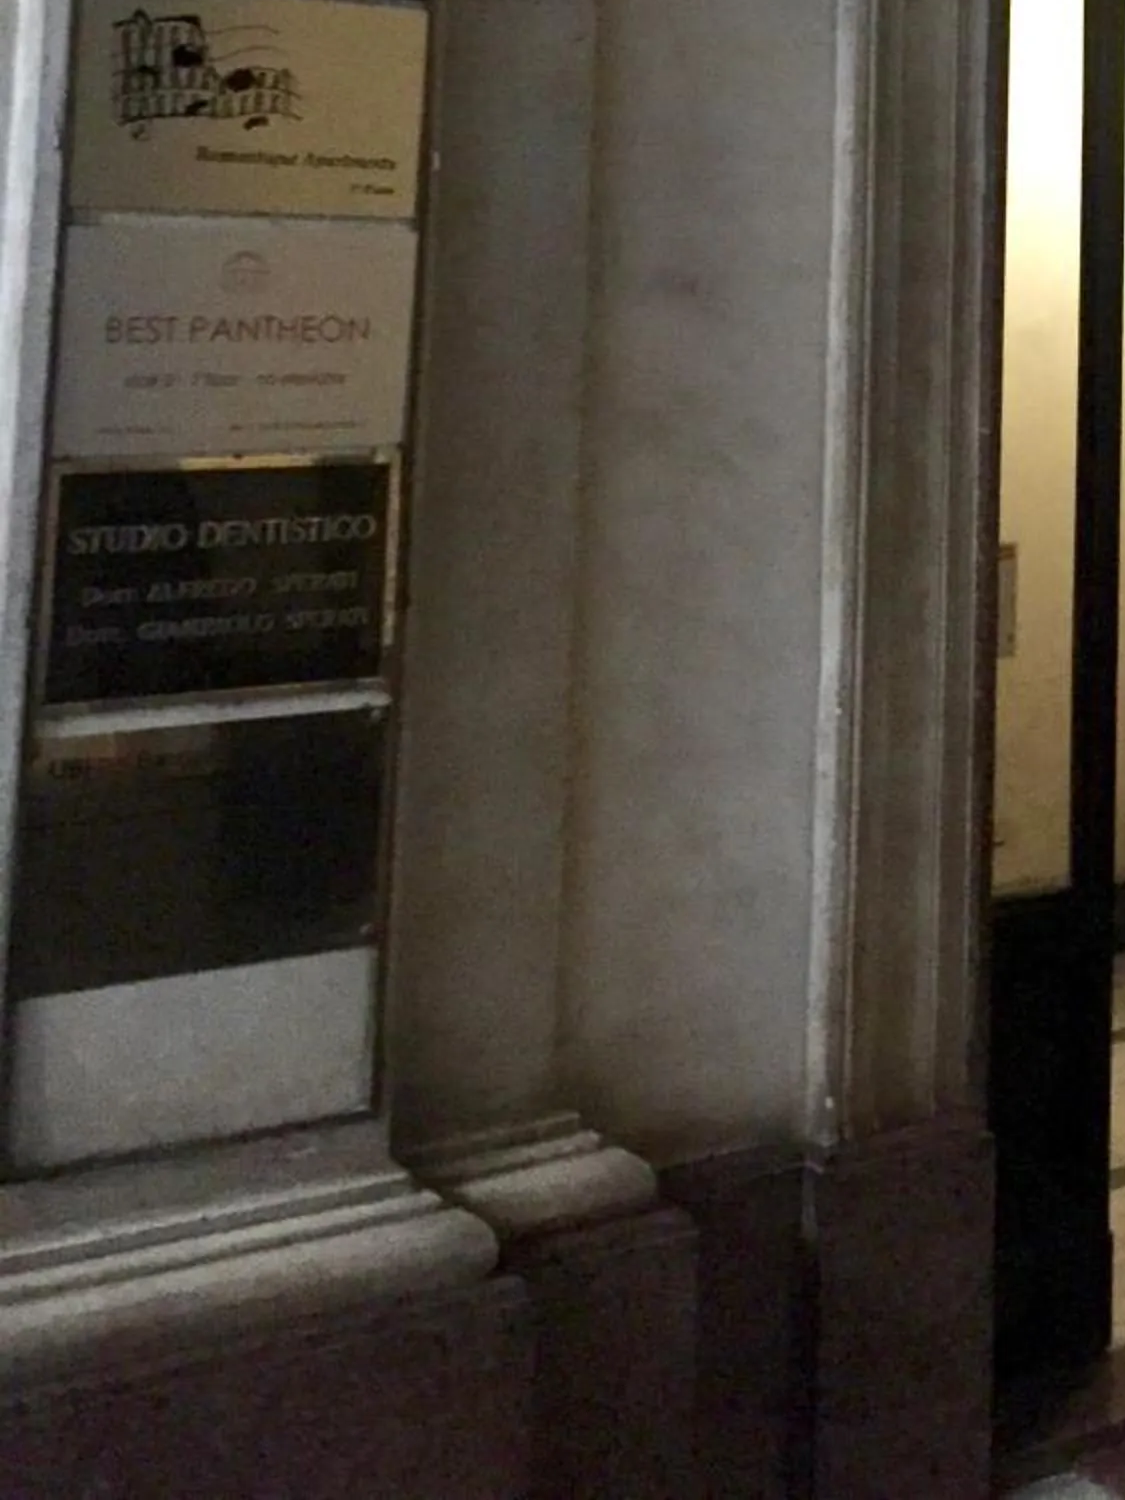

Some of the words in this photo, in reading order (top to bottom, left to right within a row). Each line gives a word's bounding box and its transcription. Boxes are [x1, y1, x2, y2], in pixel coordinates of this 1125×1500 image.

[104, 316, 179, 343] BEST
[189, 315, 371, 343] PANTHEON
[68, 523, 188, 555] STUDIO
[197, 514, 377, 550] DENTISTICO
